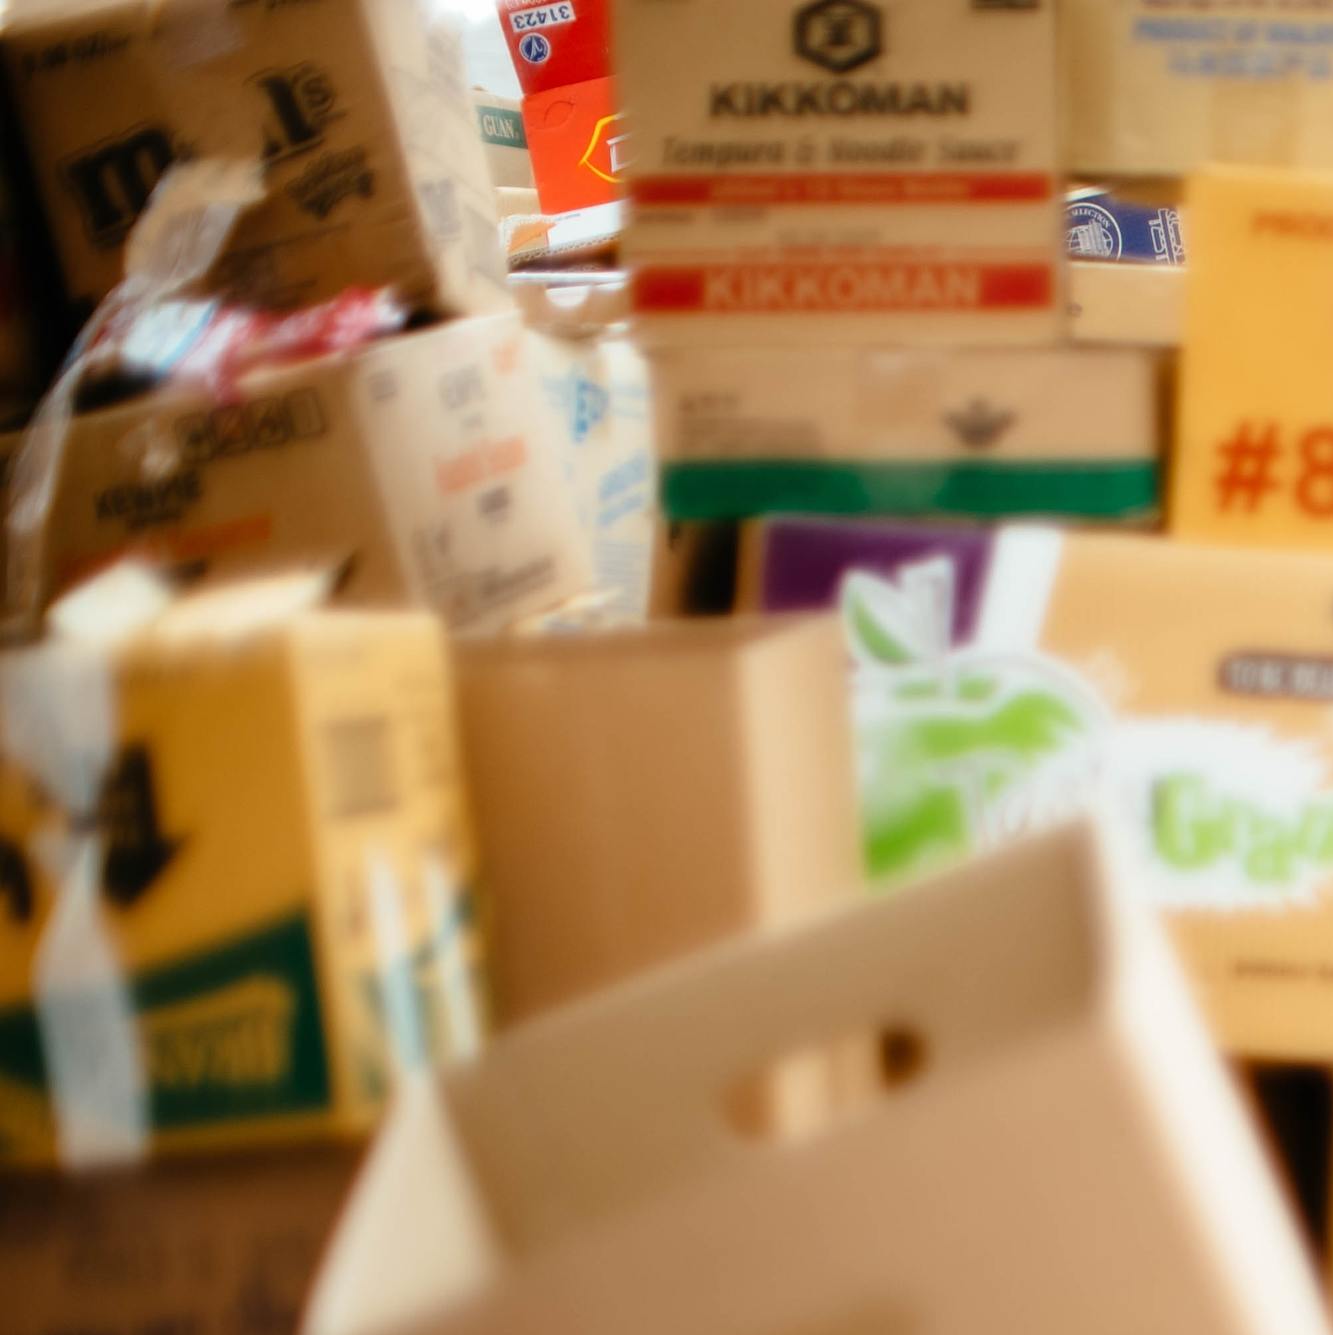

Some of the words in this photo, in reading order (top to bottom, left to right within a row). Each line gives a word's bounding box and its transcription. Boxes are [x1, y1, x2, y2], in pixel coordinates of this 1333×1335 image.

[512, 3, 575, 32] 31423
[709, 82, 970, 118] KIKKOMAN
[700, 268, 983, 313] KIKKOMAN
